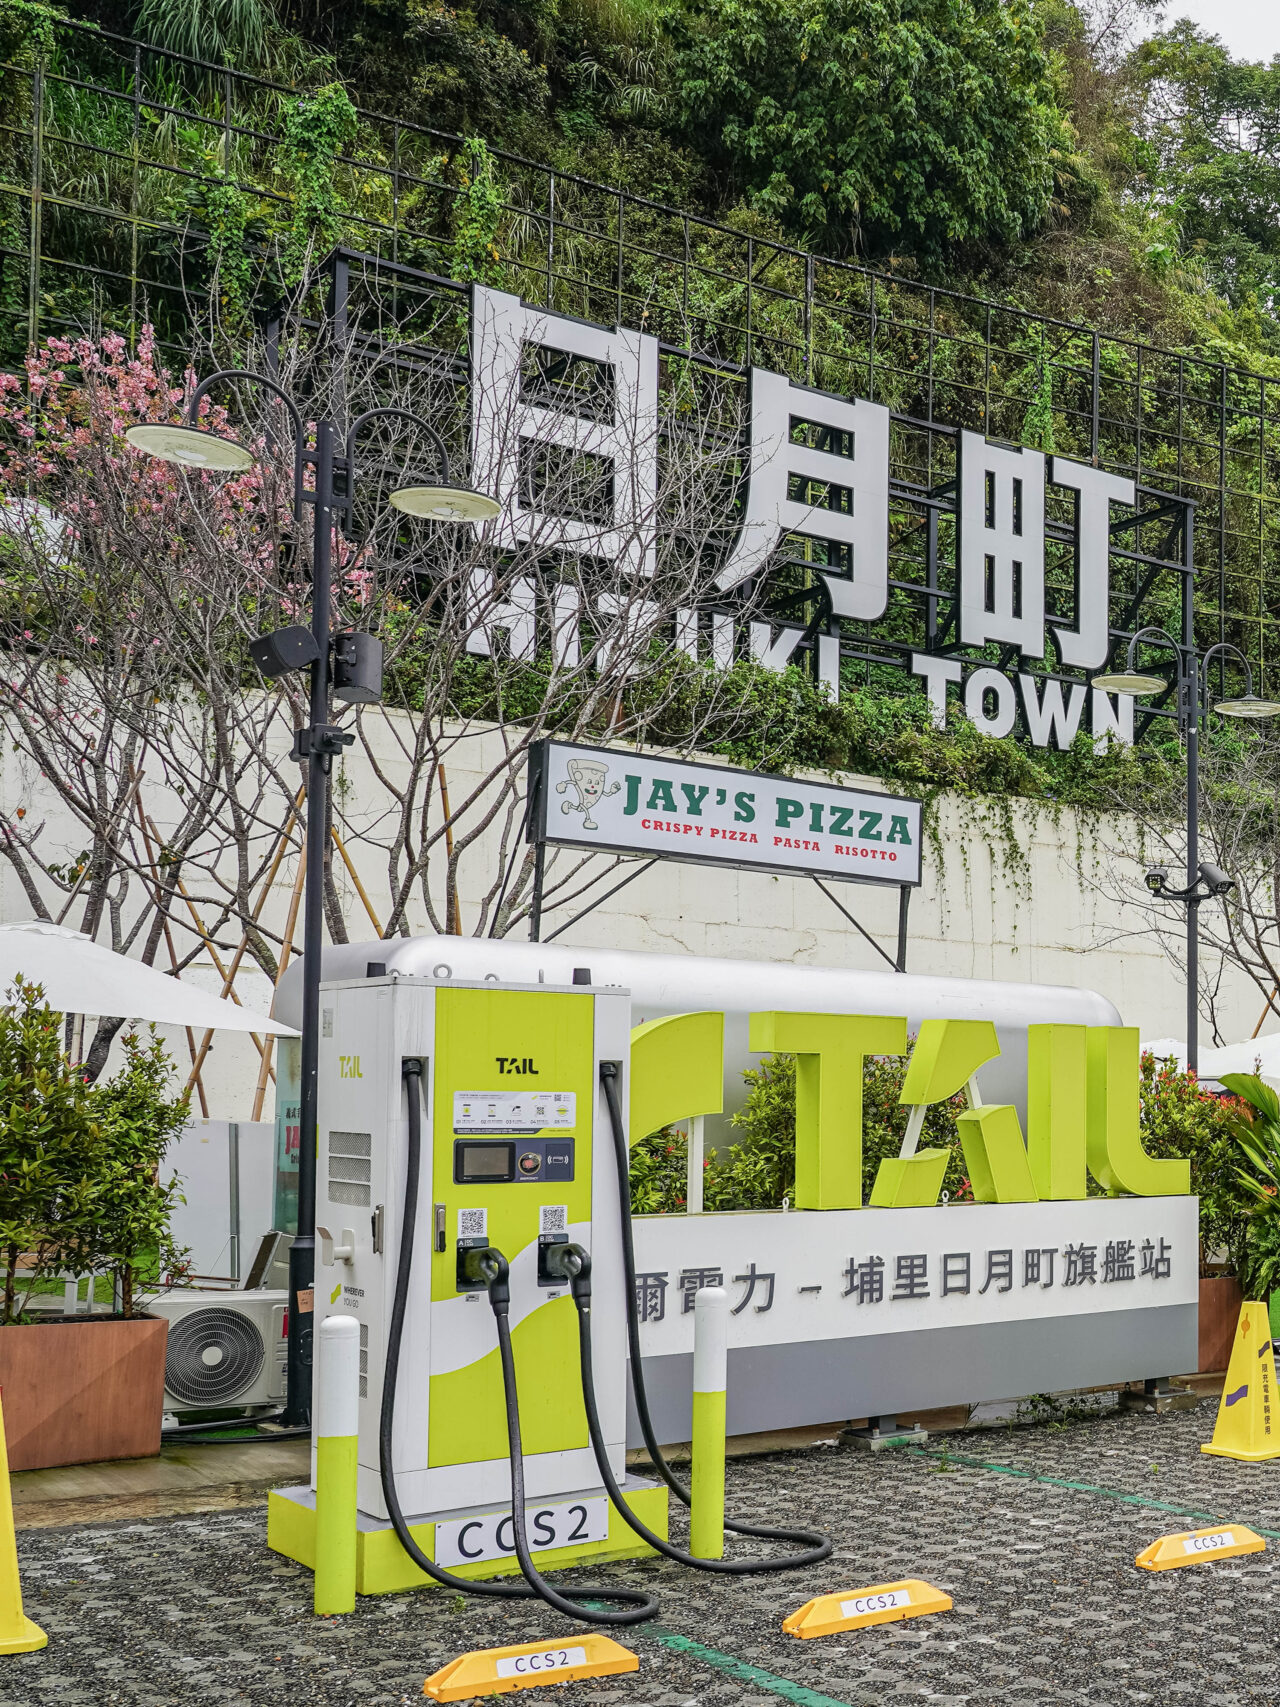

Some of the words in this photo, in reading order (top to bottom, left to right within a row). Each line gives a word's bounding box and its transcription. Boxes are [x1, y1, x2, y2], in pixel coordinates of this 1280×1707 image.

[472, 284, 1135, 670] 日月町
[912, 653, 1135, 757] TOWN
[624, 774, 756, 823] JAY'S
[775, 797, 913, 845] PIZZA
[641, 818, 704, 836] CRISPY
[710, 828, 759, 844] PIZZA
[773, 836, 821, 852] PASTA
[834, 844, 898, 862] RISOTTO
[339, 1055, 363, 1079] TAIL
[495, 1057, 539, 1075] TAIL
[749, 1010, 1191, 1210] TAIL
[343, 1285, 365, 1297] WHEREVER
[840, 1237, 1173, 1304] 埔里日月町旗艦站
[457, 1505, 589, 1558] CCS2
[1193, 1534, 1226, 1550] CCS2
[855, 1593, 898, 1613] CCS2
[514, 1650, 569, 1673] CCS2
